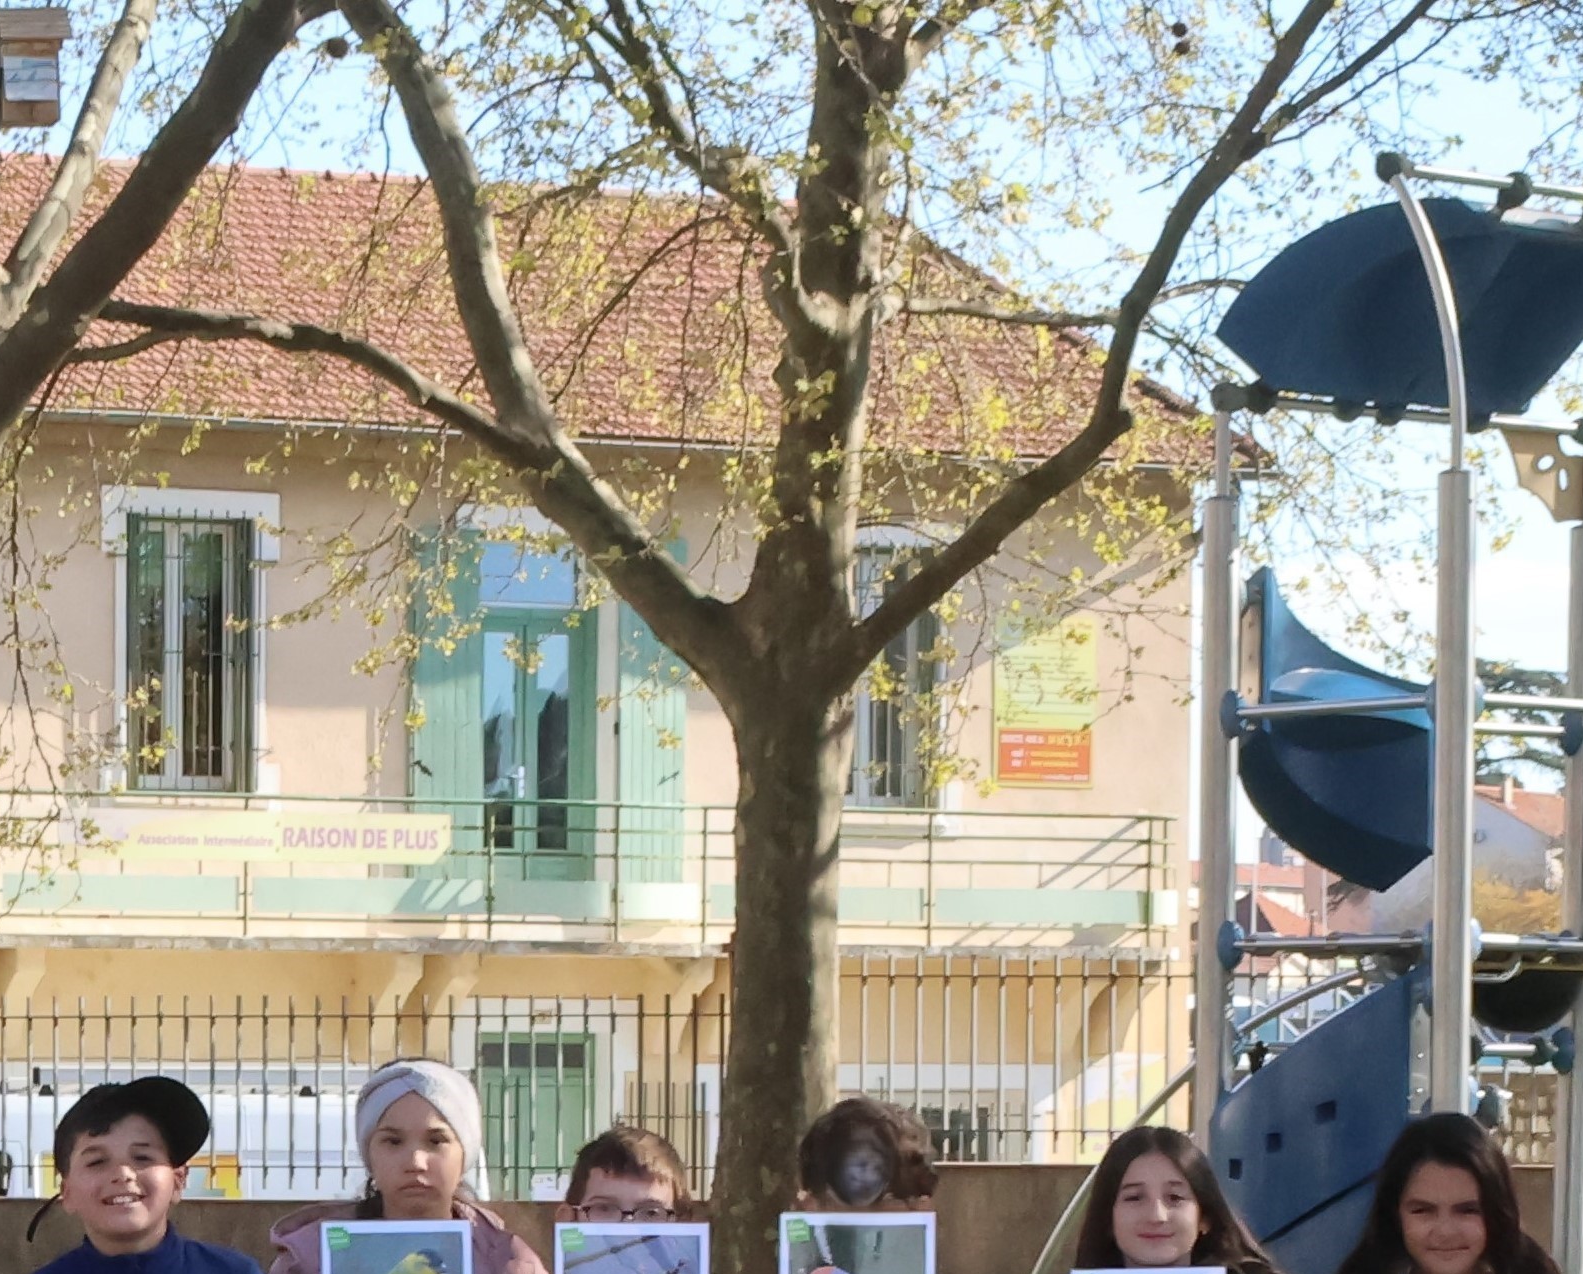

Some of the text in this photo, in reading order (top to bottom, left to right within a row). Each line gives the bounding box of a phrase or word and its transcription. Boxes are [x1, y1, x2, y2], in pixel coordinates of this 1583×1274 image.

[137, 833, 199, 847] Association
[282, 826, 439, 850] RAISON DE PLUS
